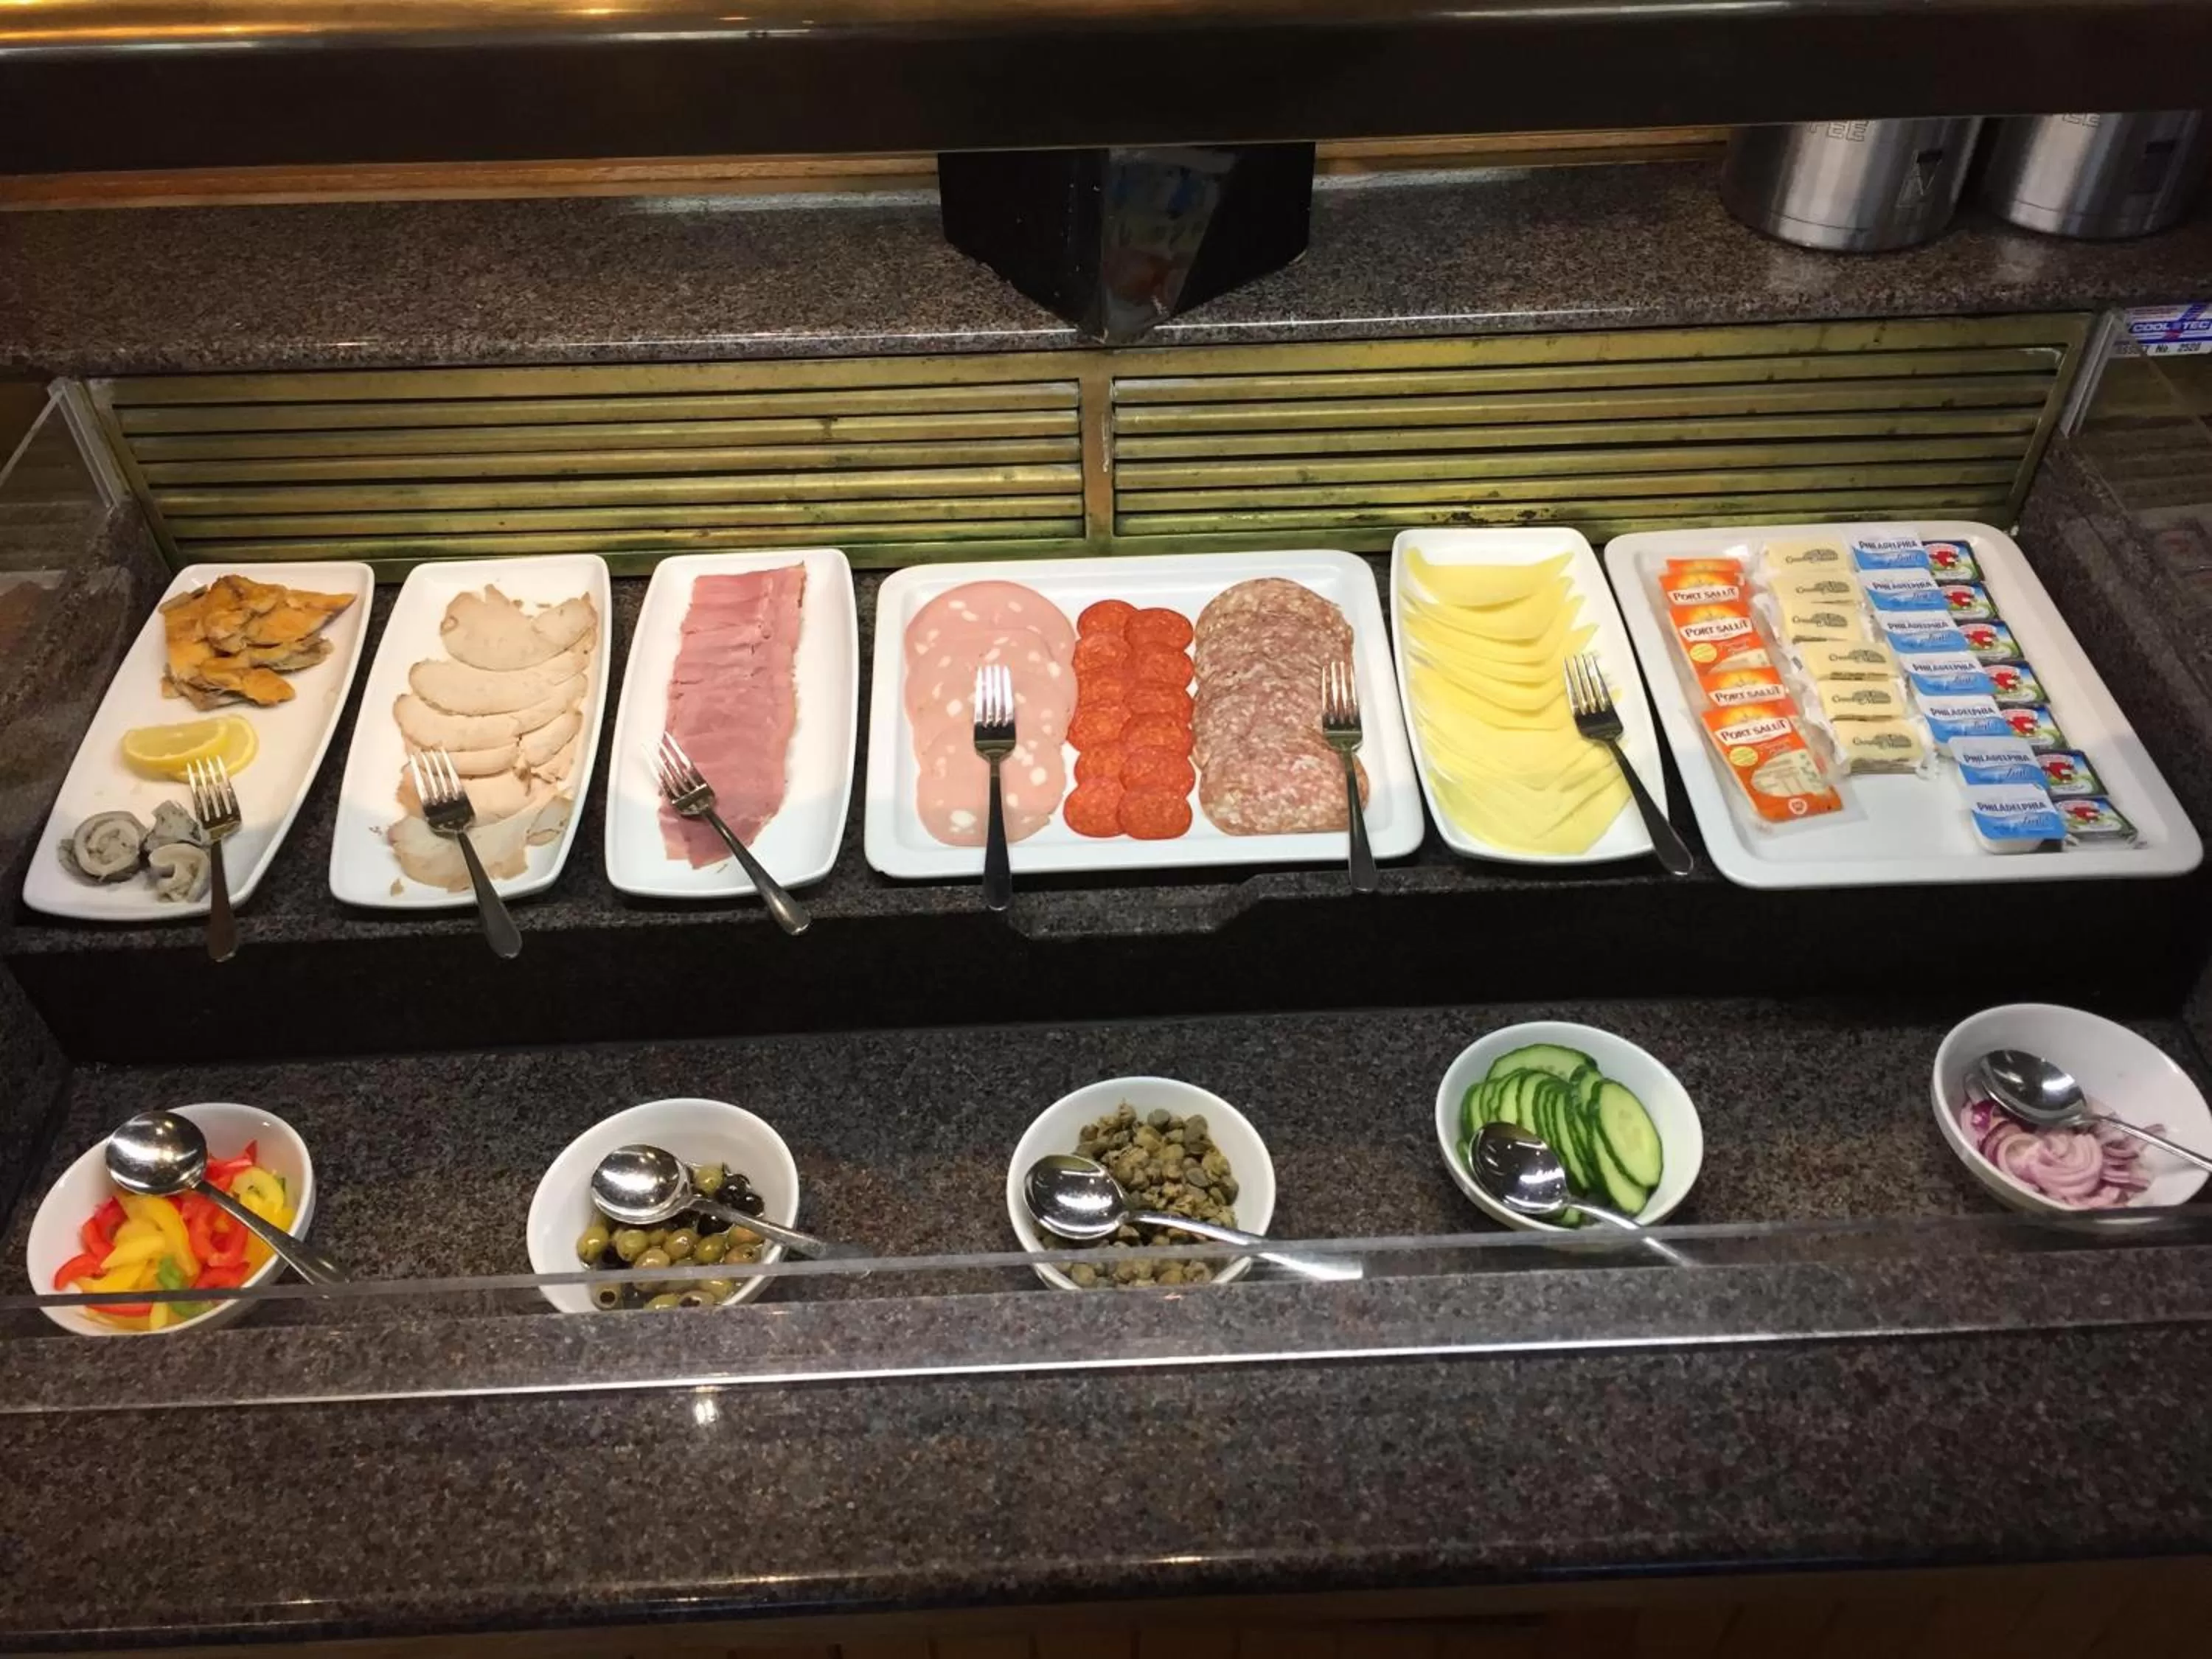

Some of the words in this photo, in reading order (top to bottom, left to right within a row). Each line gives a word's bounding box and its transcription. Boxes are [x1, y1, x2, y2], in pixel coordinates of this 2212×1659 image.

[1672, 592, 1702, 601] PORT
[1704, 588, 1736, 598] SALUT
[1684, 626, 1714, 638] PORT
[1716, 619, 1748, 633] SALUT
[1714, 691, 1745, 702] PORT
[1747, 685, 1781, 697] SALUT
[1720, 728, 1750, 741] PORT
[1752, 719, 1787, 734] SALUT
